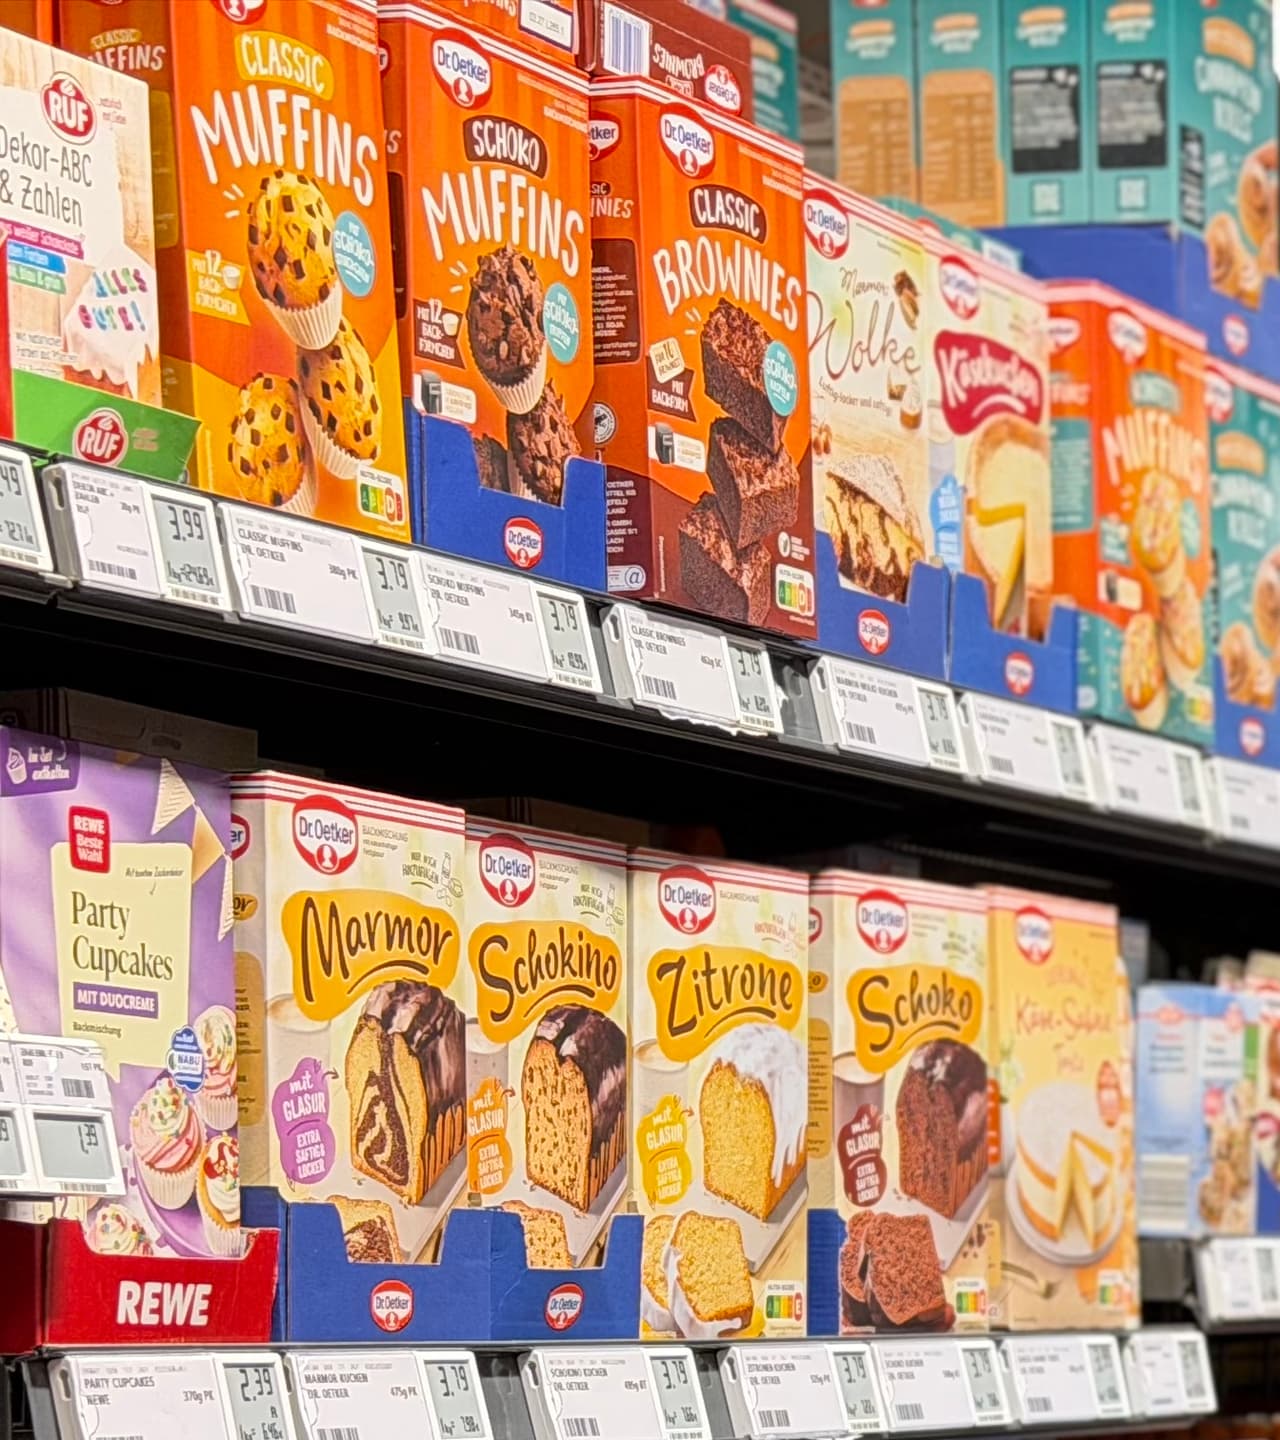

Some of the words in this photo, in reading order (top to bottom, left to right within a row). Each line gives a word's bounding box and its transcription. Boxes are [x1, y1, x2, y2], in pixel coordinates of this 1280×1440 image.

[240, 35, 325, 94] CLASSIC
[48, 89, 89, 133] RUF
[190, 85, 377, 207] MUFFINS
[472, 120, 540, 171] SCHOKO
[20, 175, 82, 227] Zahlen
[694, 188, 760, 238] CLASSIC
[421, 166, 584, 277] MUFFINS
[205, 250, 221, 277] 12
[653, 236, 801, 331] BROWNIES
[429, 298, 442, 324] 12
[810, 290, 921, 380] Wolke
[80, 428, 118, 457] RUF
[168, 506, 204, 541] 3.99
[239, 529, 269, 545] CLASSIC
[376, 557, 408, 591] 3.79
[549, 601, 578, 632] 3.79
[632, 625, 654, 640] CLASSIC
[73, 816, 105, 834] REWE
[75, 834, 104, 850] Beste
[77, 849, 103, 863] Wahl
[71, 891, 130, 940] Party
[73, 935, 173, 981] Cupcakes
[301, 896, 453, 1003] Marmor
[478, 926, 617, 1022] Schokino
[77, 989, 97, 1007] MIT
[100, 993, 155, 1013] DUOCREME
[656, 951, 793, 1038] Zitrone
[858, 970, 973, 1052] Schoko
[73, 1021, 121, 1039] Backmischung
[178, 1055, 200, 1065] NABU
[289, 1074, 314, 1095] mit
[282, 1092, 326, 1122] GLASUR
[472, 1094, 494, 1111] mit
[652, 1106, 672, 1126] mit
[466, 1108, 504, 1134] GLASUR
[851, 1118, 871, 1135] mit
[296, 1134, 321, 1152] EXTRA
[646, 1124, 684, 1151] GLASUR
[845, 1133, 880, 1156] GLASUR
[117, 1280, 213, 1326] REWE
[84, 1376, 110, 1389] PARTY
[112, 1375, 155, 1389] CUPCAKES
[239, 1369, 274, 1402] 2.39
[304, 1372, 336, 1385] MARMOR
[339, 1371, 368, 1384] KUCHEN
[437, 1366, 469, 1398] 3.79
[583, 1367, 608, 1378] KUCHEN
[663, 1361, 688, 1390] 3.79
[842, 1358, 866, 1384] 3.79
[87, 1394, 112, 1406] REWE
